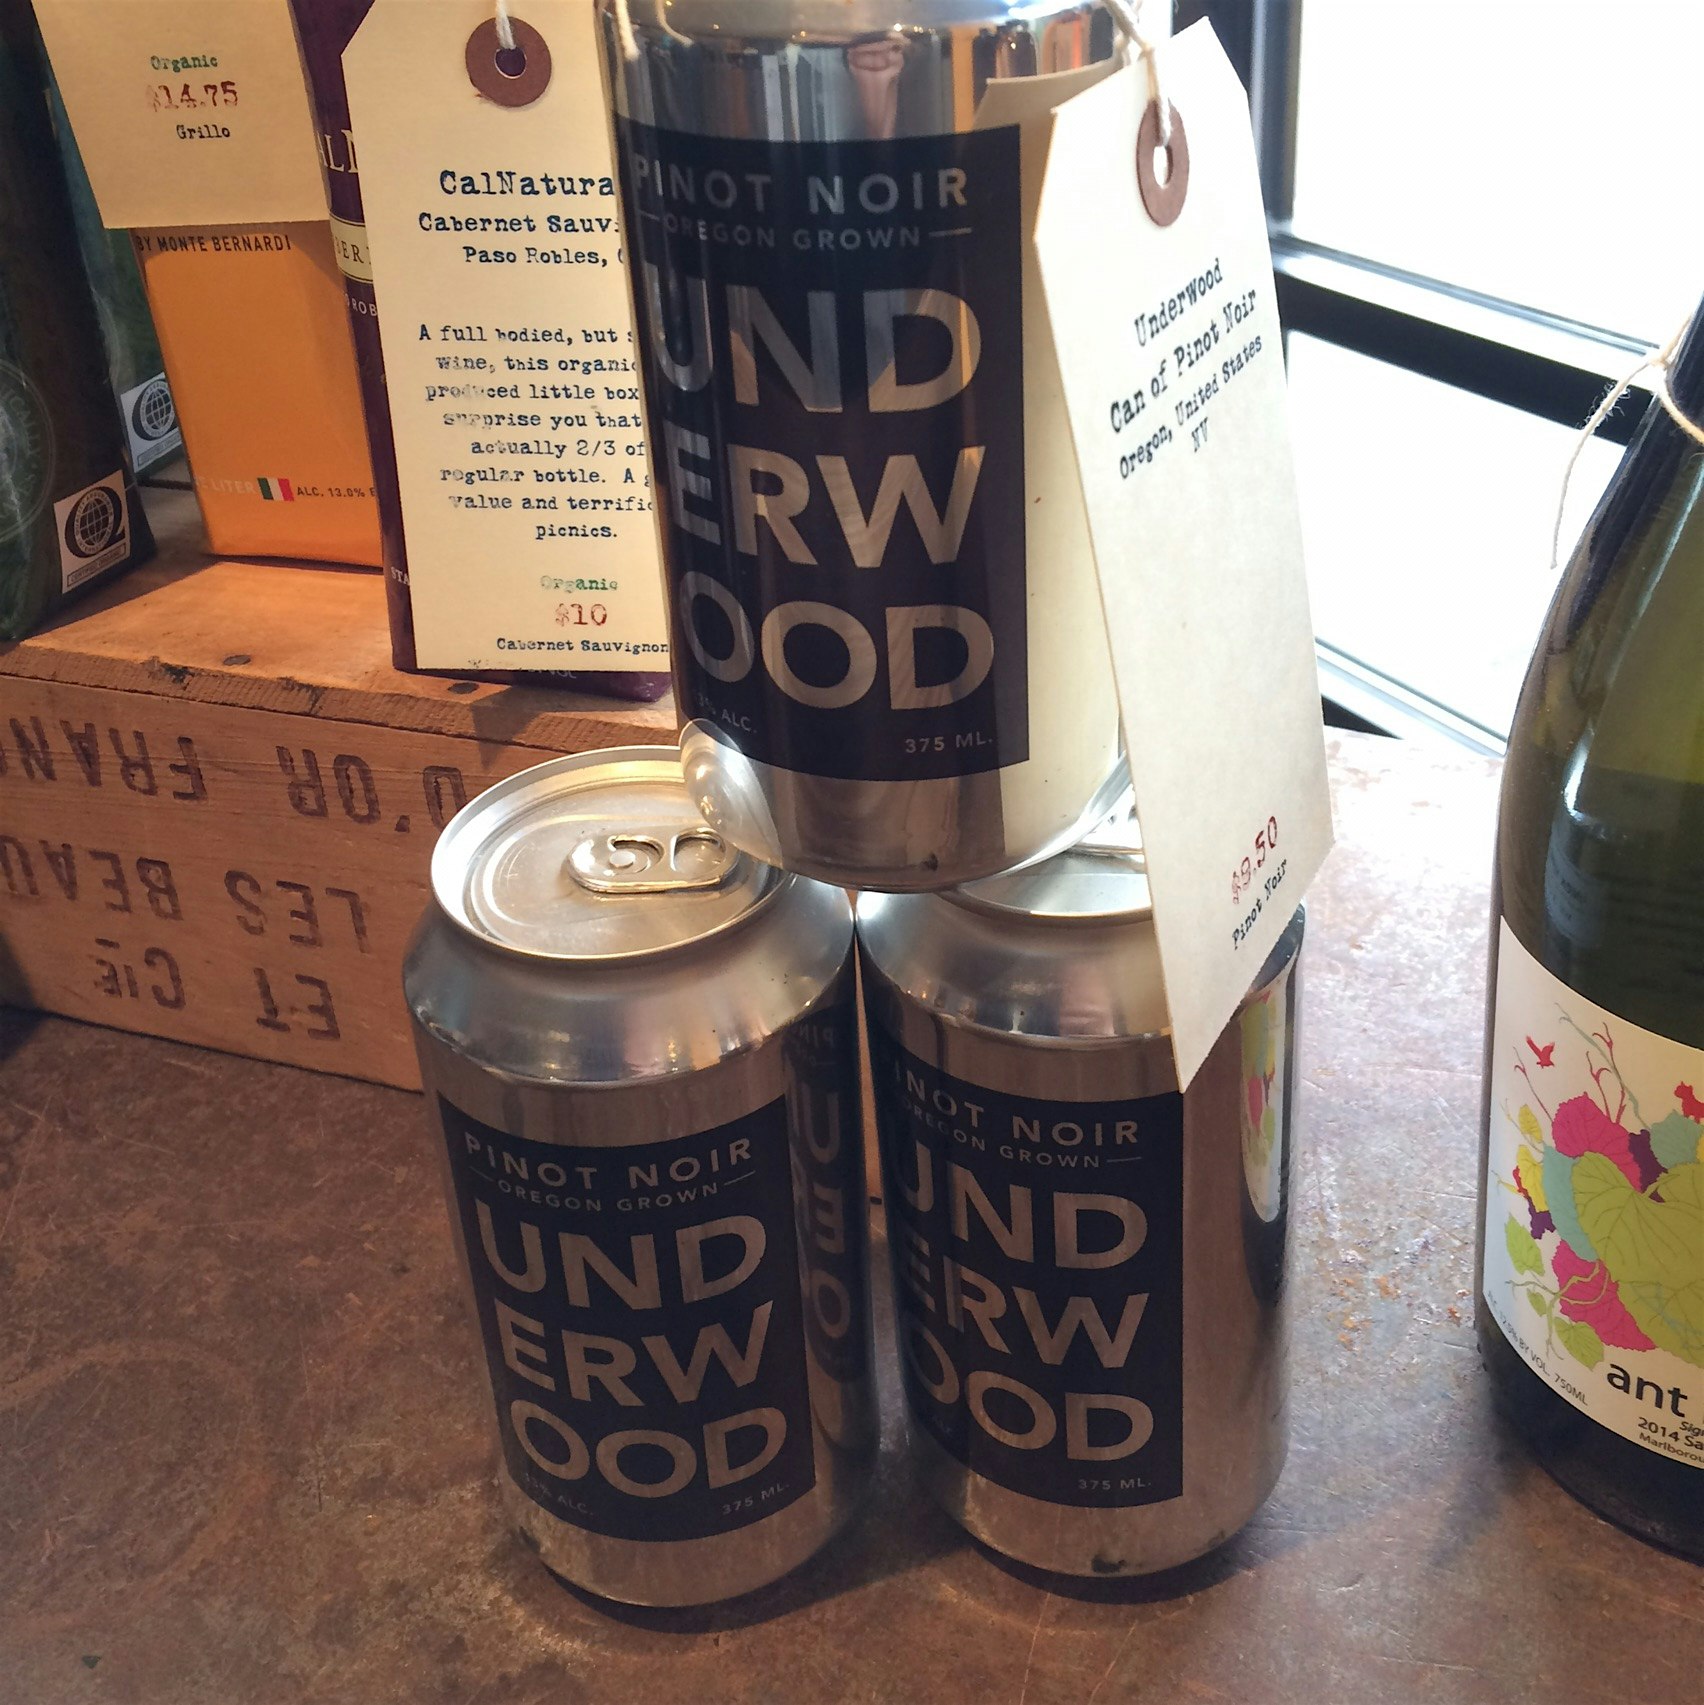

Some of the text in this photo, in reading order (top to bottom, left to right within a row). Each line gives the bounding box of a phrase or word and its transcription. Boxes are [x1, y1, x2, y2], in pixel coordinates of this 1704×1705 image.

[150, 55, 218, 72] Organic
[147, 81, 238, 112] $14.75
[176, 125, 230, 139] Grillo
[440, 170, 614, 196] CalNatura
[633, 153, 968, 214] PINOT NOIR
[419, 212, 536, 232] Cabernet
[664, 216, 920, 251] OREGON GROWN
[137, 235, 291, 252] BY MONTE BERNARDI
[463, 246, 516, 263] Paso
[526, 248, 608, 267] Robles,
[1134, 257, 1223, 348] Underwood
[419, 325, 431, 340] A
[441, 326, 487, 342] full
[496, 328, 573, 345] bodied,
[583, 330, 617, 343] but
[645, 262, 981, 413] UND
[504, 356, 549, 371] this
[1110, 289, 1256, 433] Can of Pinot Noir
[529, 385, 595, 400] little
[604, 387, 639, 400] box
[1119, 335, 1262, 480] Oregon, United States
[443, 409, 642, 430] surprise you that
[1191, 417, 1208, 453] NV
[471, 440, 646, 458] actually 2/3 of
[211, 478, 256, 494] LITER
[297, 486, 324, 497] ALC.
[328, 487, 365, 498] 13.0%
[440, 468, 524, 484] regular
[533, 469, 607, 484] bottle.
[623, 468, 635, 484] A
[522, 497, 558, 509] and
[662, 422, 986, 569] ERW
[536, 524, 618, 540] picnics.
[541, 575, 618, 592] Organic
[555, 603, 608, 627] $10
[497, 637, 669, 654] Cabernet Sauvignon
[679, 570, 994, 710] OOD
[0, 716, 207, 801] FRAN
[905, 734, 993, 754] 375 ML.
[1231, 815, 1278, 905] $9.50
[224, 870, 370, 954] LES
[1232, 859, 1287, 951] Pinot Noir
[254, 967, 341, 1041] ET
[1012, 1115, 1138, 1147] NOIR
[464, 1131, 751, 1190] PINOT NOIR
[1000, 1145, 1099, 1168] GROWN
[498, 1180, 718, 1211] OREGON GROWN
[474, 1198, 767, 1311] UND
[903, 1216, 1149, 1369] ERW
[494, 1297, 774, 1407] ERW
[910, 1320, 1154, 1462] OOD
[1555, 1373, 1588, 1406] 750ML
[1607, 1363, 1688, 1418] ant
[1638, 1417, 1680, 1442] 2014
[510, 1398, 788, 1498] OOD
[1078, 1479, 1111, 1491] 375
[722, 1495, 754, 1516] 375
